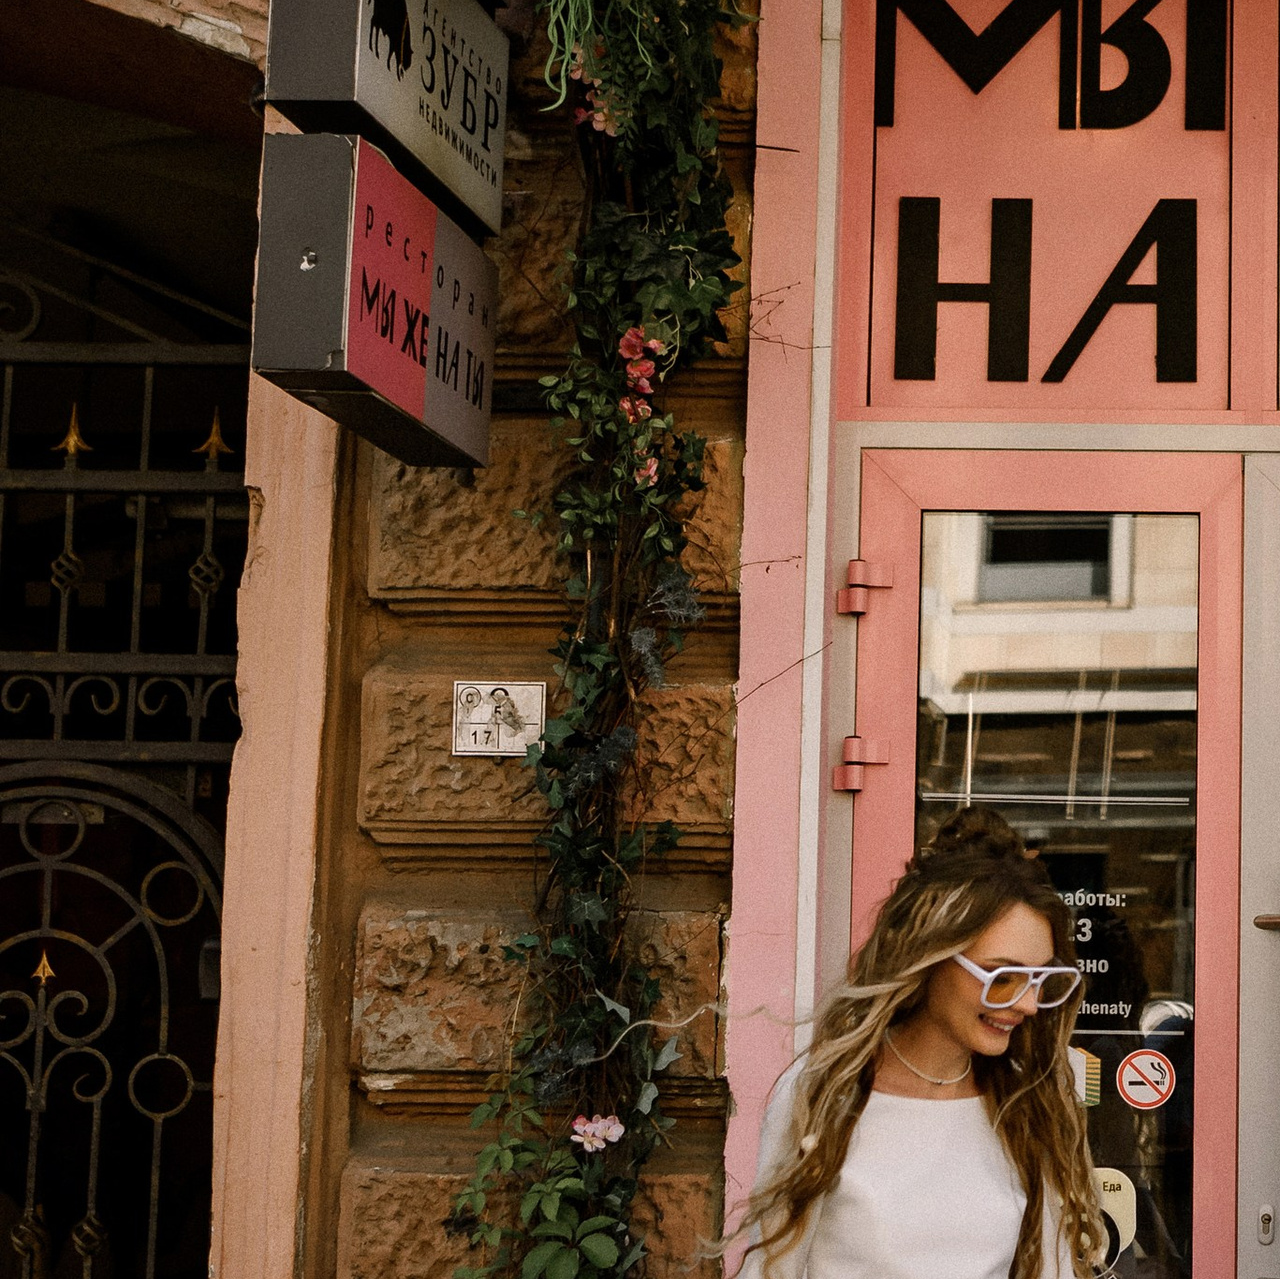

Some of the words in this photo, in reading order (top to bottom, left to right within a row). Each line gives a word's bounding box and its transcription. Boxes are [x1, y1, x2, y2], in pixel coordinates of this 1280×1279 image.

[418, 97, 498, 188] НЕДВИЖИМОСТИ
[420, 23, 499, 153] ЗУБР
[360, 266, 397, 344] МЫ
[401, 298, 429, 369] ЖЕ
[436, 326, 460, 392] НА
[465, 348, 485, 410] ТЫ
[893, 196, 1199, 384] НА
[1102, 1181, 1122, 1193] Еда
